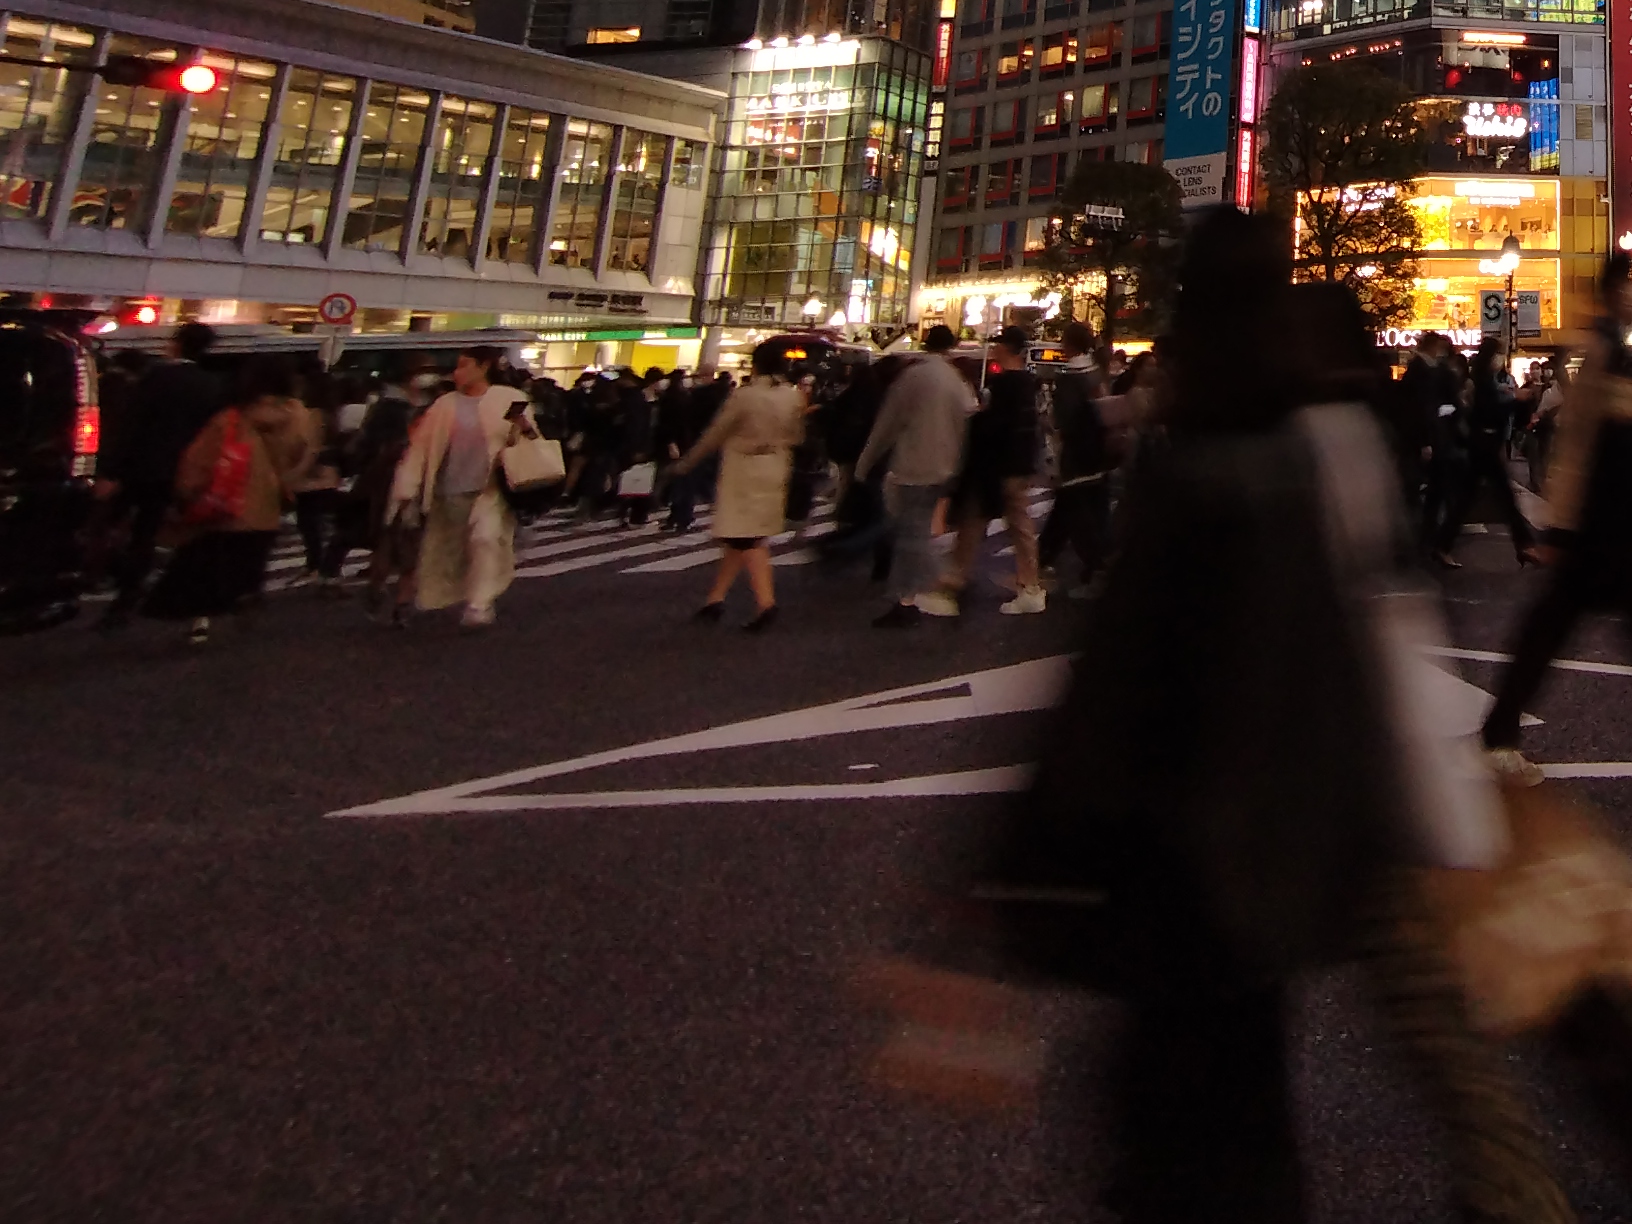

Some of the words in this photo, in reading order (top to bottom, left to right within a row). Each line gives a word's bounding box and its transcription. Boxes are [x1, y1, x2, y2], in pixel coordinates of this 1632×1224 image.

[1175, 164, 1211, 177] CONTACT
[1183, 176, 1203, 187] LENS
[1181, 186, 1217, 198] CIALISTS
[1376, 328, 1481, 347] L'OCCANE
